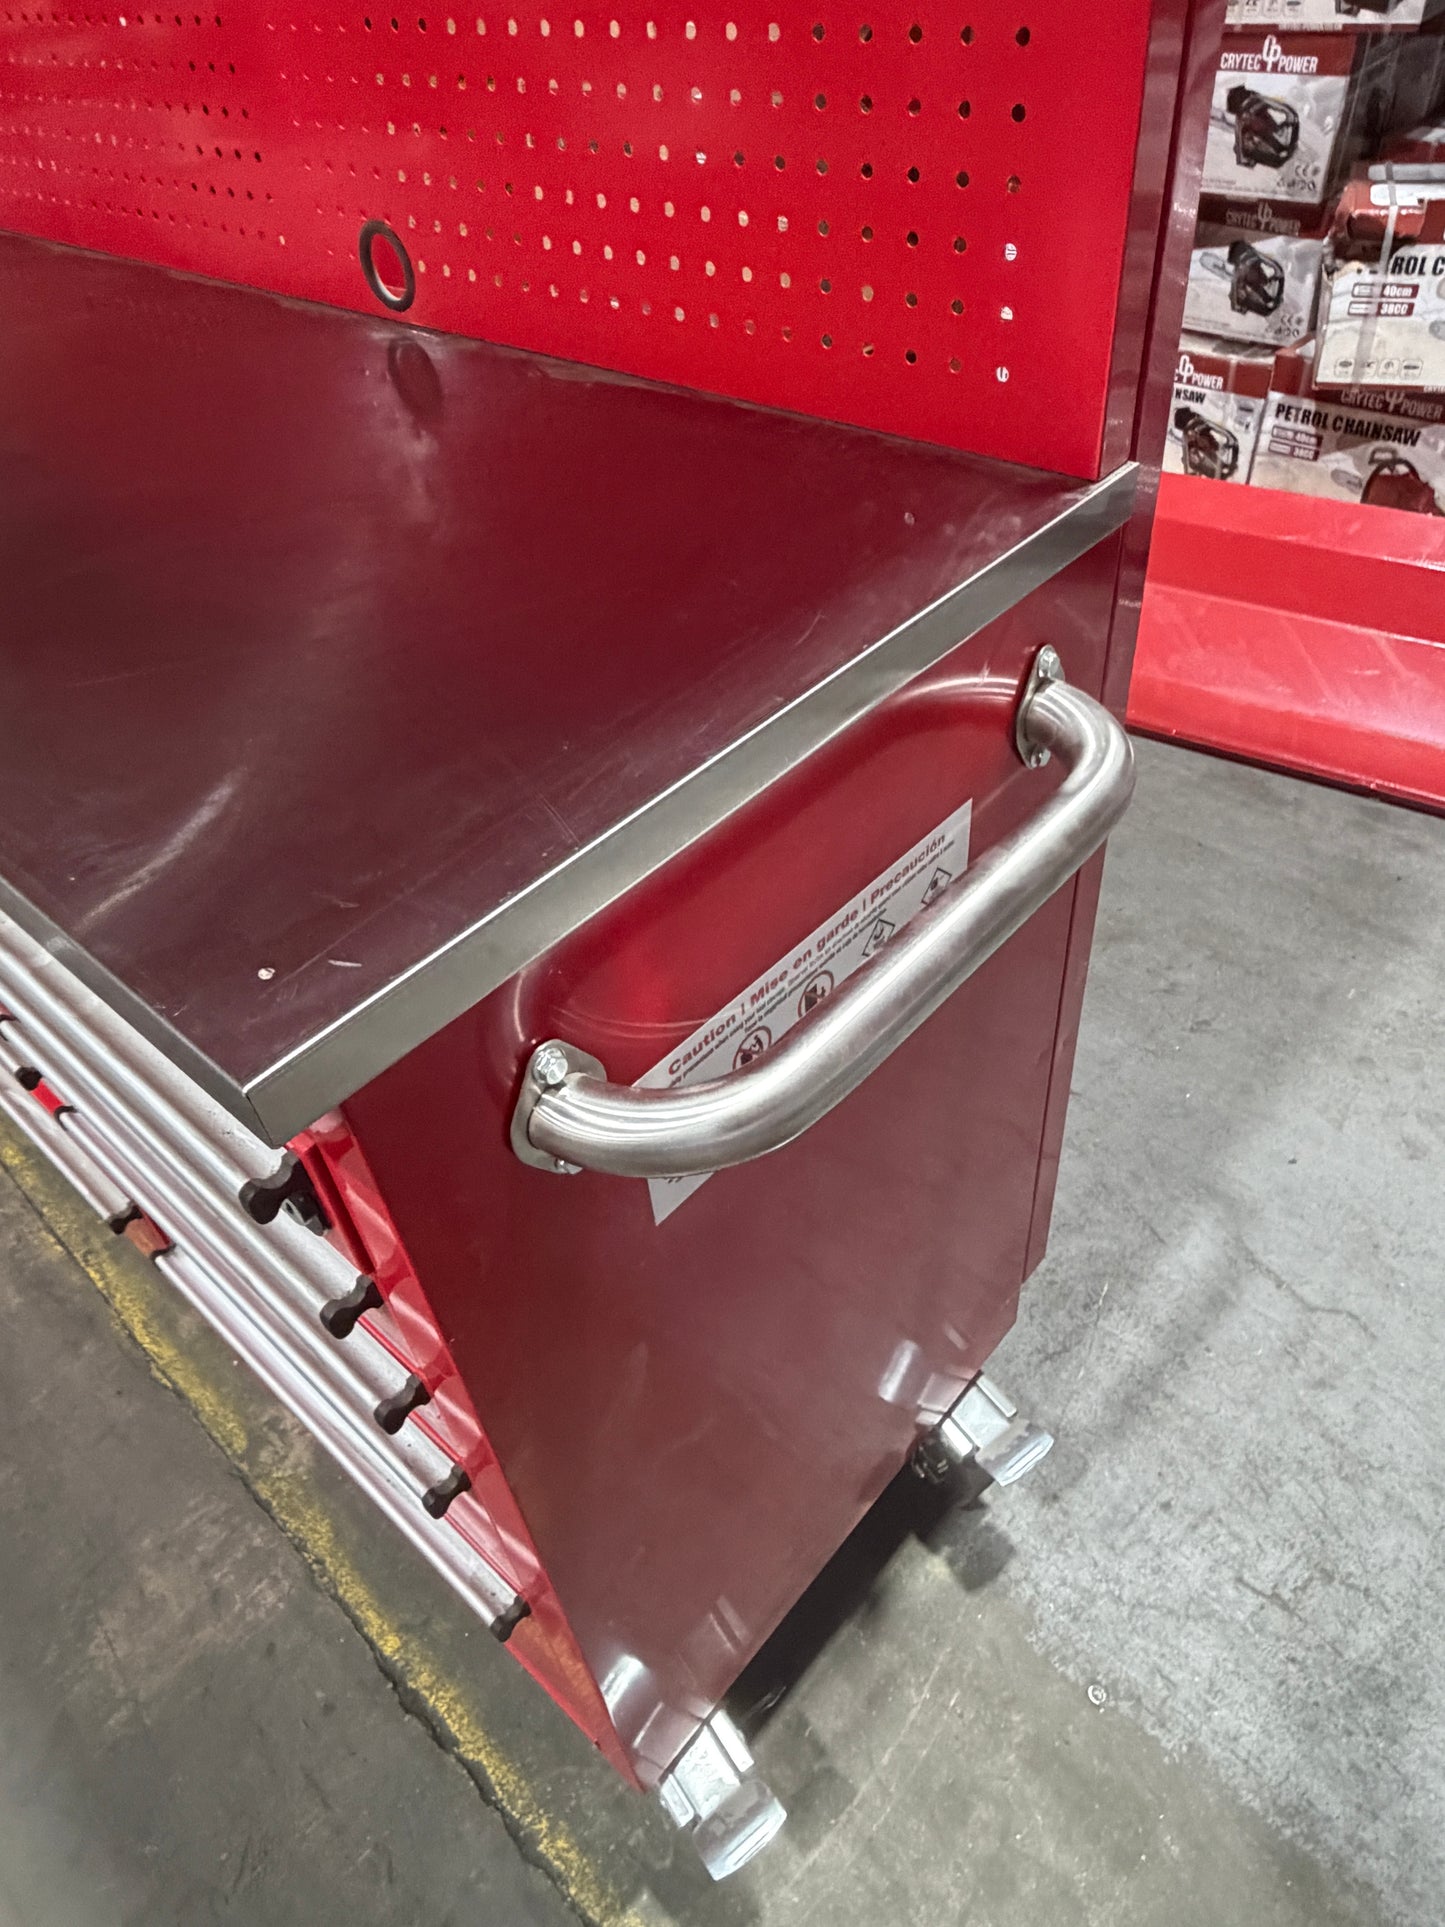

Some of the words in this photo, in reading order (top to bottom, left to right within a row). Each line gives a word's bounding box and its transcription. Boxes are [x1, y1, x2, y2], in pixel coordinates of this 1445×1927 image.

[1220, 52, 1261, 71] CRYTEC
[1278, 54, 1318, 73] POWER
[1383, 285, 1413, 297] 40cm
[1192, 372, 1224, 390] POWER
[1400, 399, 1444, 420] POWER
[1275, 403, 1329, 431] PETROL
[1332, 415, 1422, 447] CHAINSAW
[668, 1014, 736, 1075] Caution
[750, 970, 788, 1007] Mise
[793, 949, 812, 969] en
[816, 908, 859, 952] garde
[870, 834, 946, 904] Precaución
